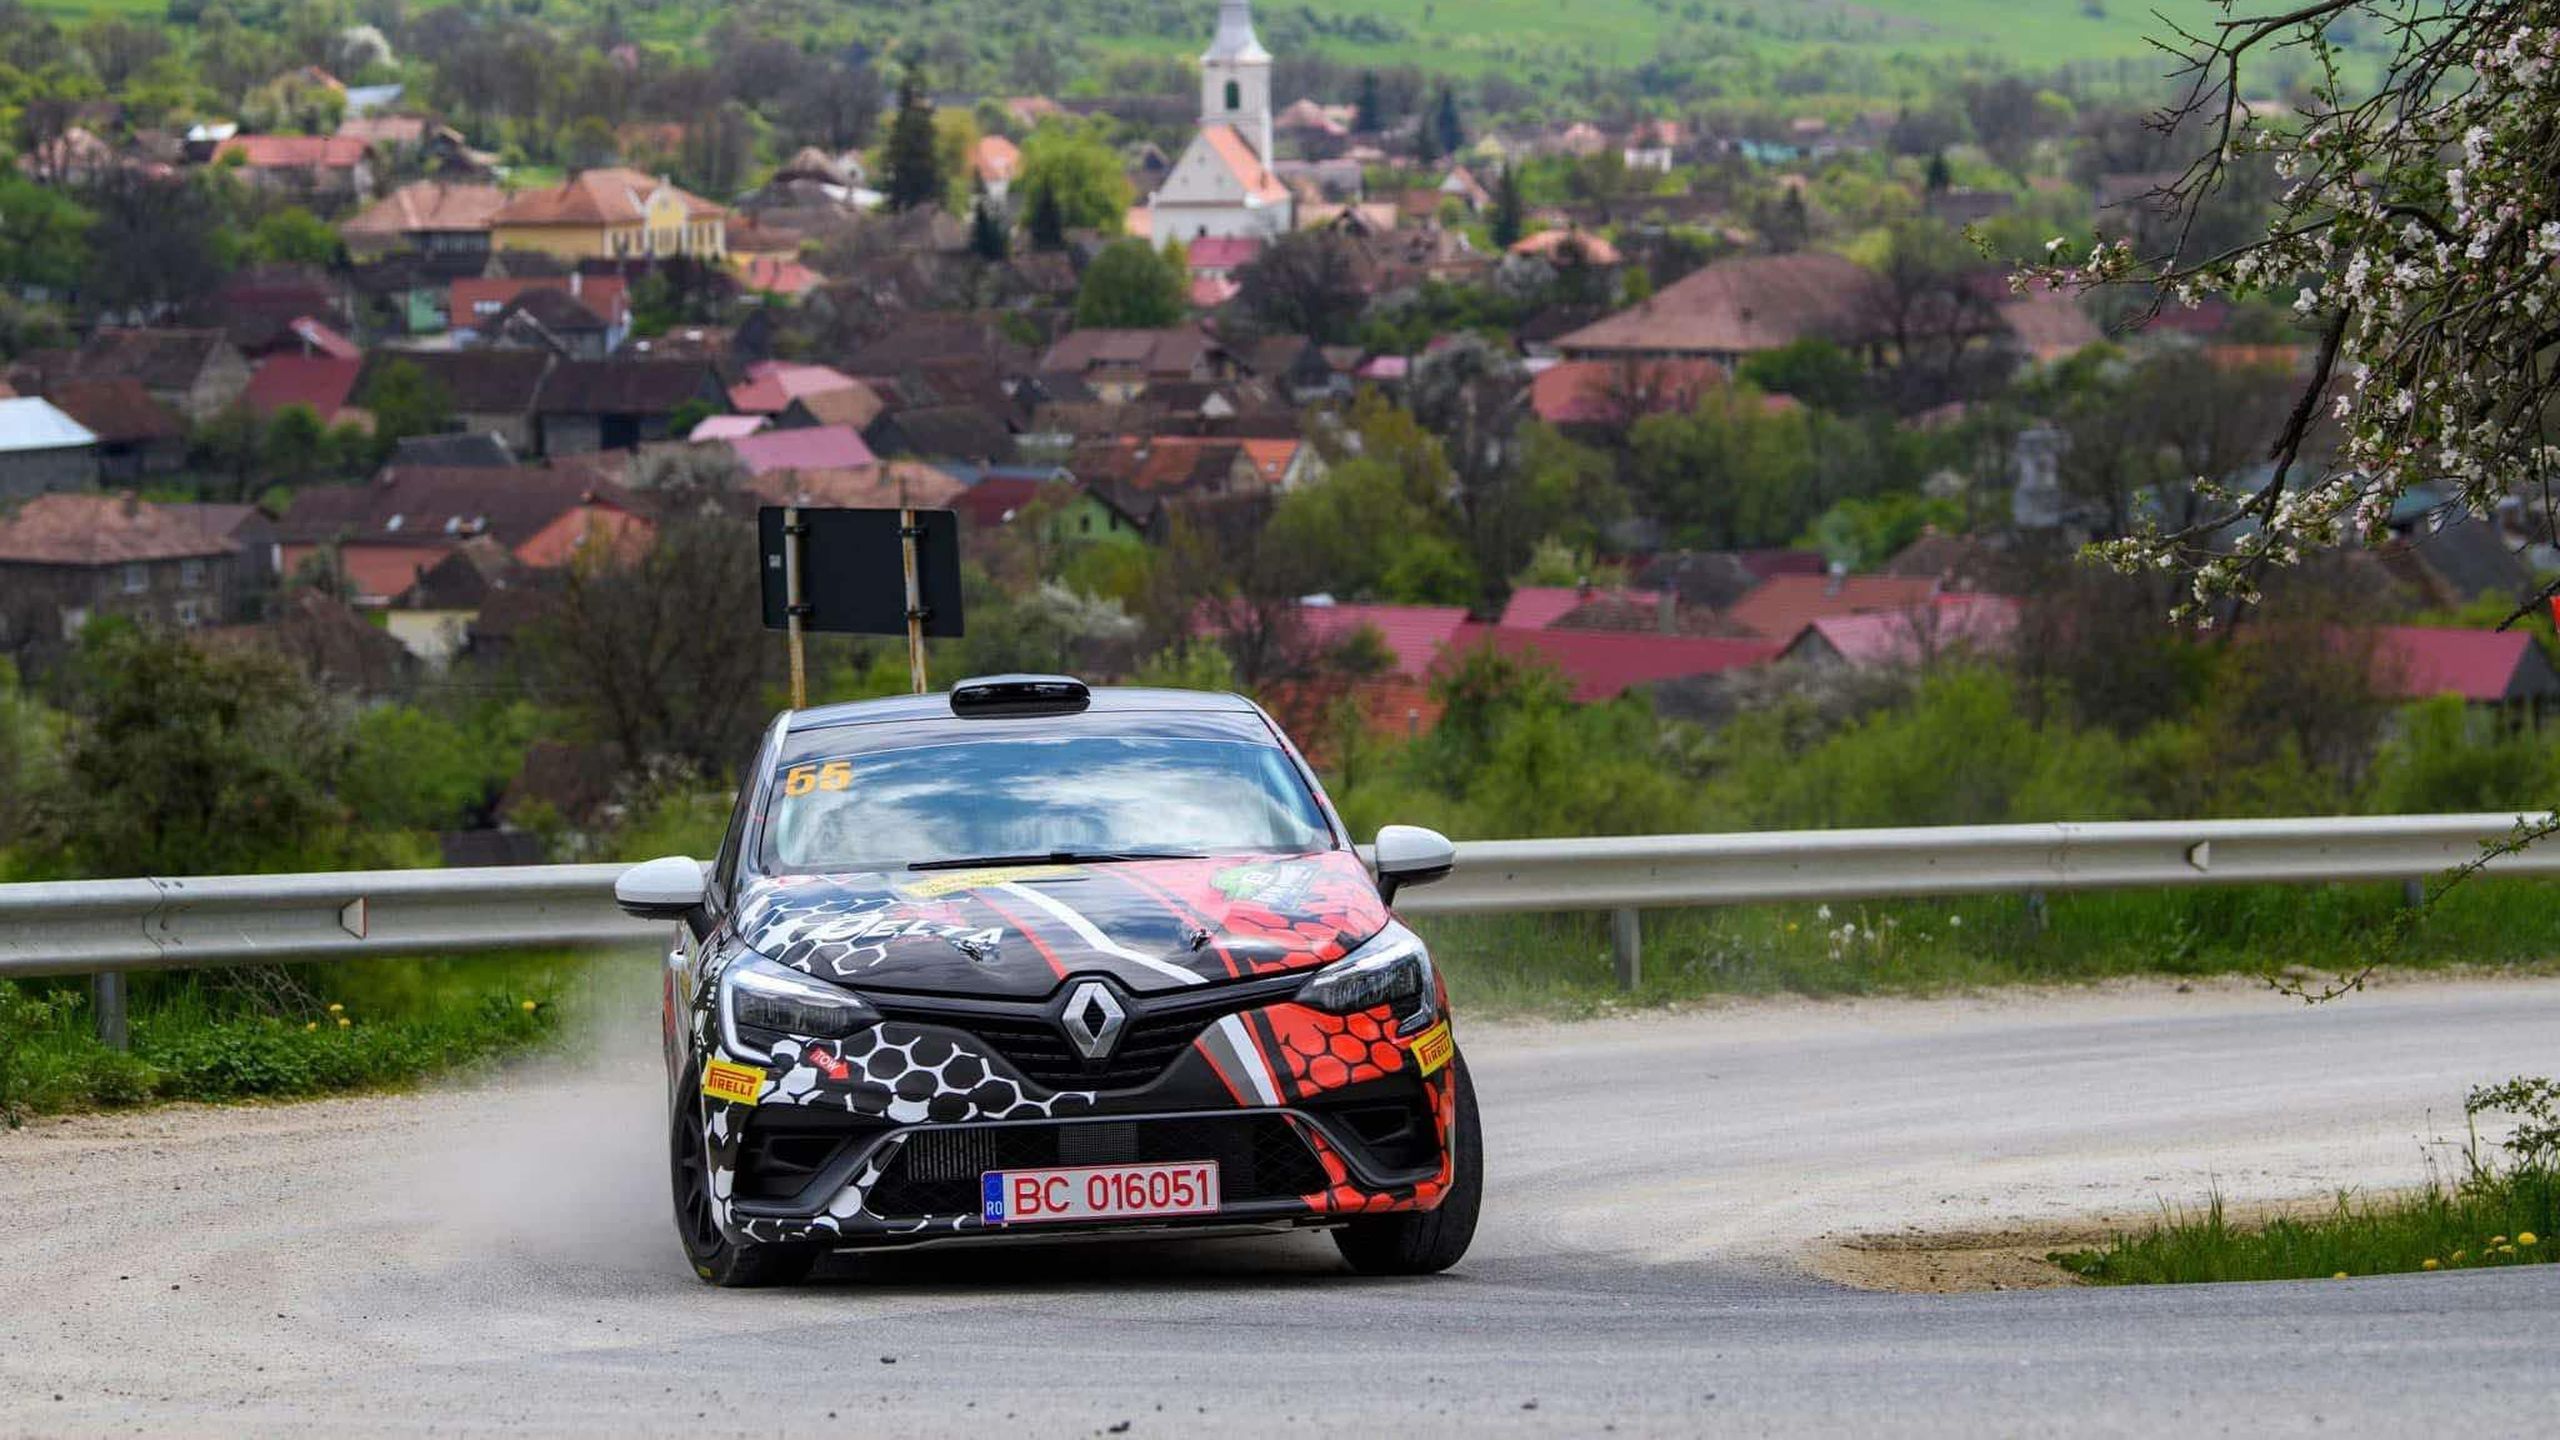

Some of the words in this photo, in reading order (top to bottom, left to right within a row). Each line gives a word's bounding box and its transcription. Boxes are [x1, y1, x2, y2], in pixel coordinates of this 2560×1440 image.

[809, 1048, 840, 1072] TOW
[708, 1067, 757, 1097] PIRELLI
[1014, 1177, 1070, 1215] BC
[1087, 1169, 1208, 1211] 016051
[986, 1200, 1003, 1216] RO
